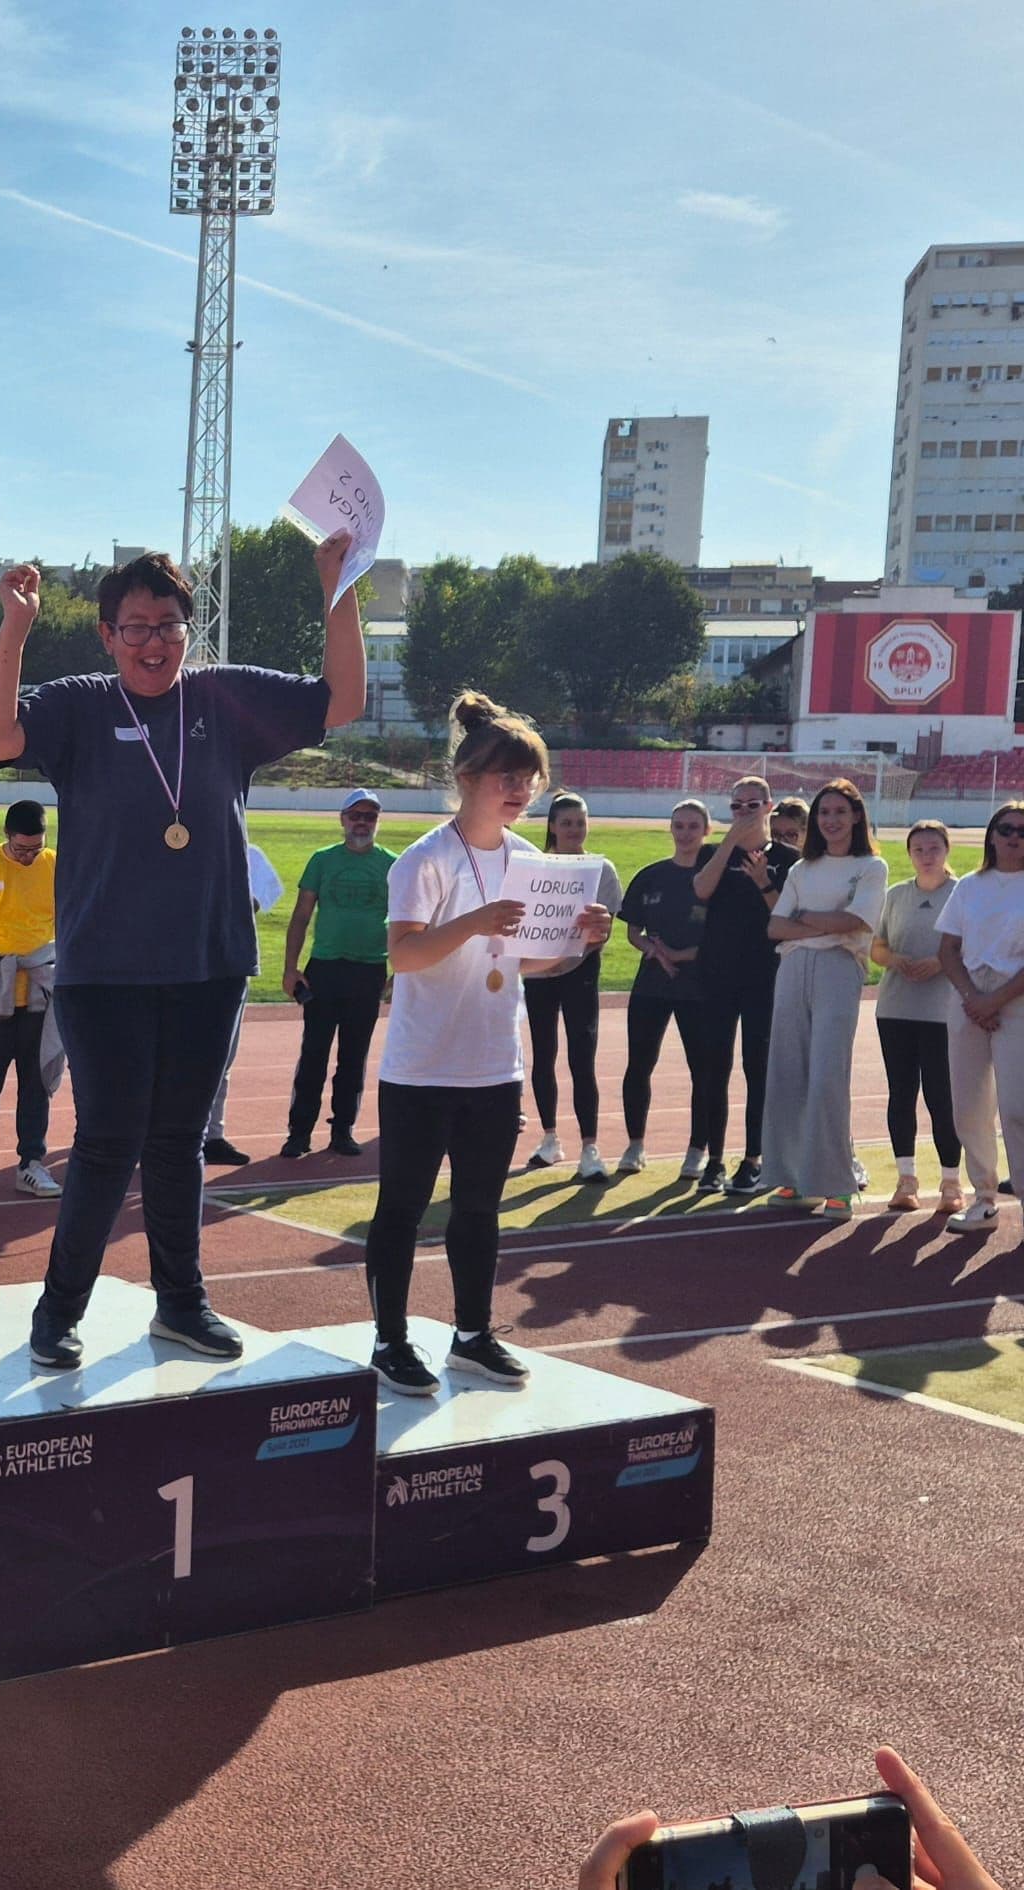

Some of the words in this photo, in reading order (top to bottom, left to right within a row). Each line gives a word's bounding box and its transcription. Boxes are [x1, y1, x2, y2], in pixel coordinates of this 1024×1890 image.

[338, 469, 353, 486] 2
[894, 687, 923, 695] SPLIT
[531, 880, 584, 895] UDRUGA
[533, 903, 576, 918] DOWN
[512, 926, 568, 940] INDROM
[270, 1397, 351, 1421] EUROPEAN
[270, 1415, 325, 1433] THROWING
[326, 1412, 349, 1425] CUP
[6, 1433, 94, 1460] EUROPEAN
[628, 1427, 695, 1452] EUROPEAN
[674, 1443, 693, 1456] CUP
[5, 1450, 93, 1477] ATHLETICS
[411, 1463, 483, 1487] EUROPEAN
[410, 1477, 482, 1502] ATHLETICS
[526, 1459, 571, 1553] 3
[157, 1474, 194, 1580] 1
